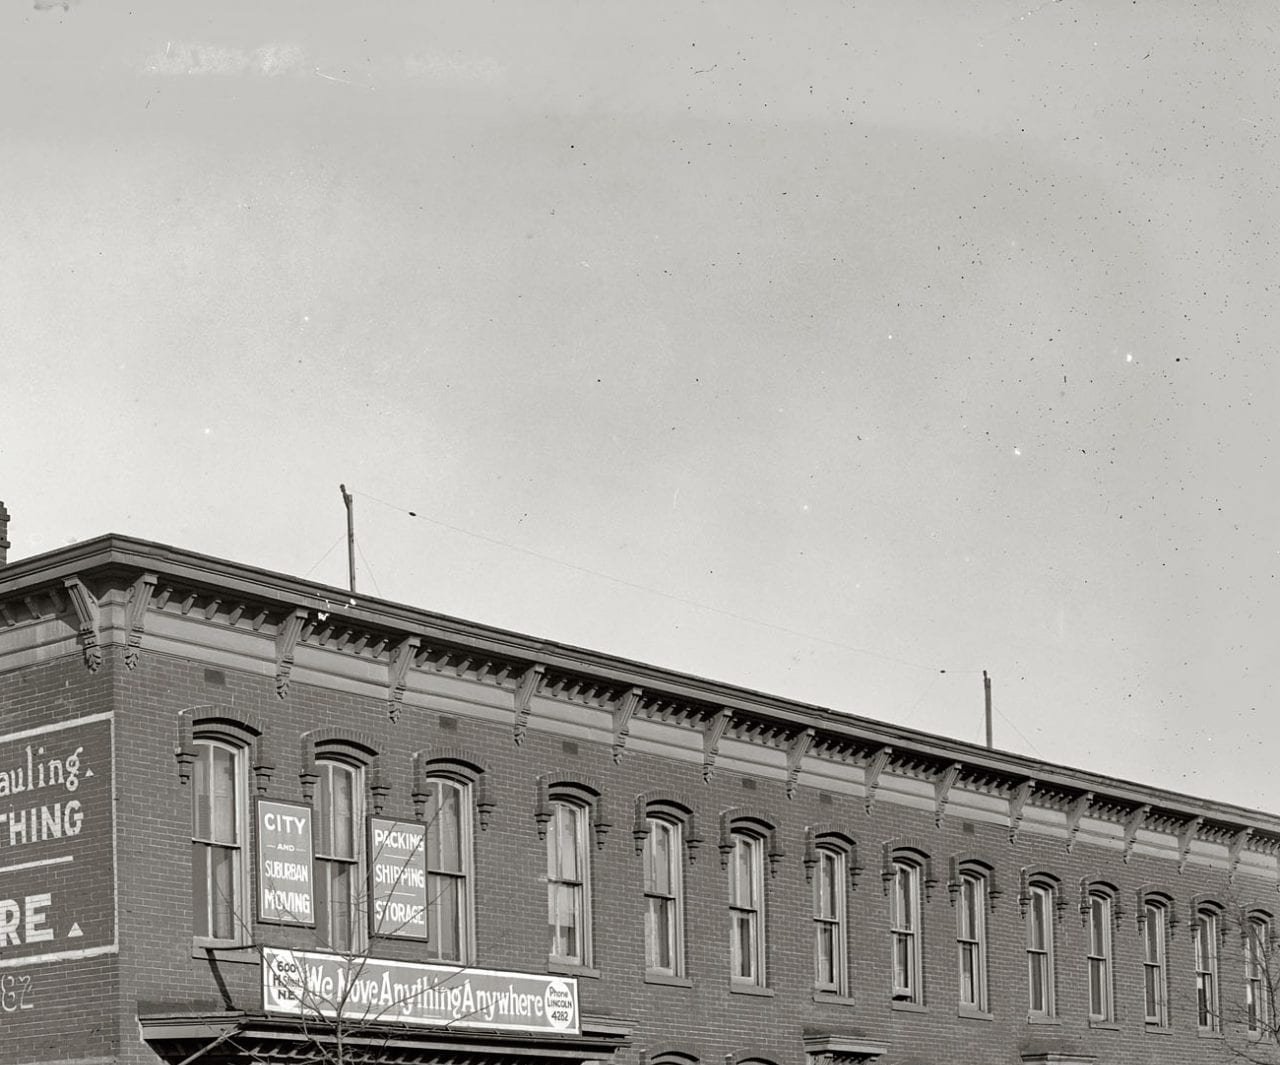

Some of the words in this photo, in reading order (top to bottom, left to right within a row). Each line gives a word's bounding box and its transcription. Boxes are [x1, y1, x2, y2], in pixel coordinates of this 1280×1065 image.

[264, 813, 306, 835] CITY
[276, 843, 295, 852] AND
[374, 829, 424, 851] PACKING
[265, 860, 308, 882] SUBURBAN
[375, 864, 424, 888] SHIPPING
[264, 889, 311, 914] MOVING
[376, 901, 424, 925] STORAGE
[277, 961, 296, 973] 600
[305, 963, 334, 1000] We
[336, 968, 379, 1005] Move
[379, 970, 464, 1018] Anything
[462, 979, 544, 1021] Anywhere
[549, 986, 569, 998] Phone
[547, 998, 572, 1009] LINCOLN
[551, 1010, 569, 1022] 4282
